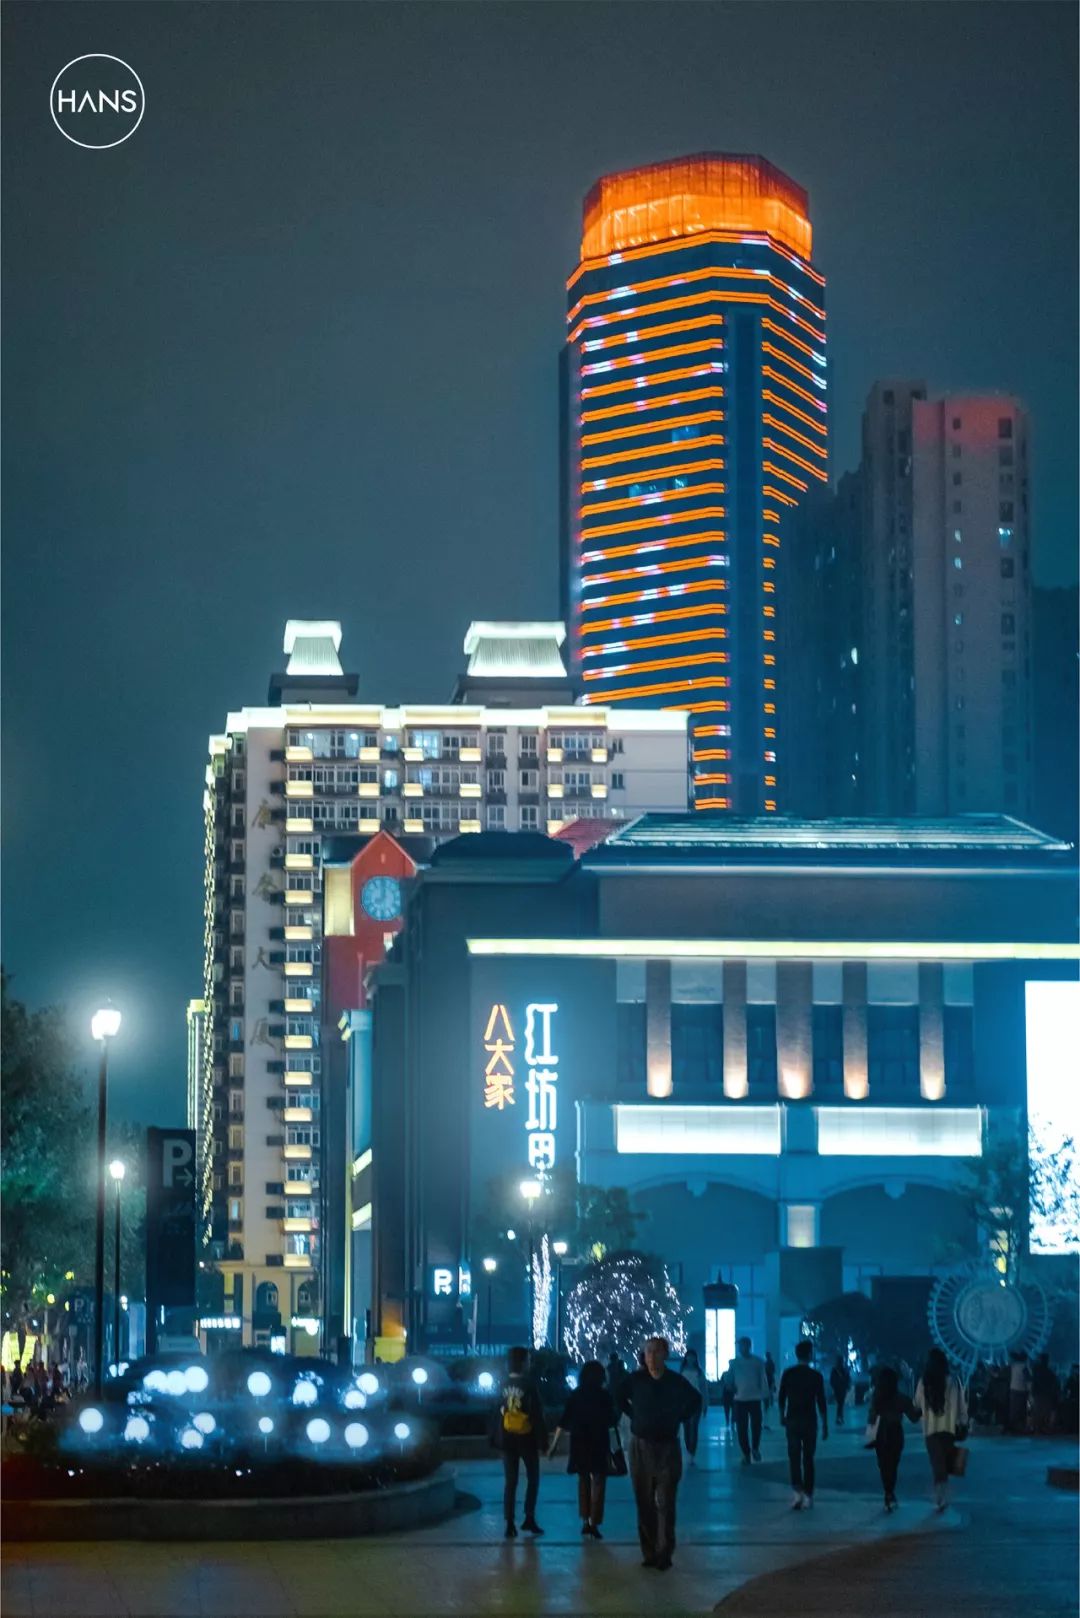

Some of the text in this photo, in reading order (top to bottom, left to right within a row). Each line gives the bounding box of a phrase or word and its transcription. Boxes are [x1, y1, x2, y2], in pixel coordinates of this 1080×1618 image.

[484, 1004, 516, 1110] 八大家
[163, 1139, 193, 1187] P
